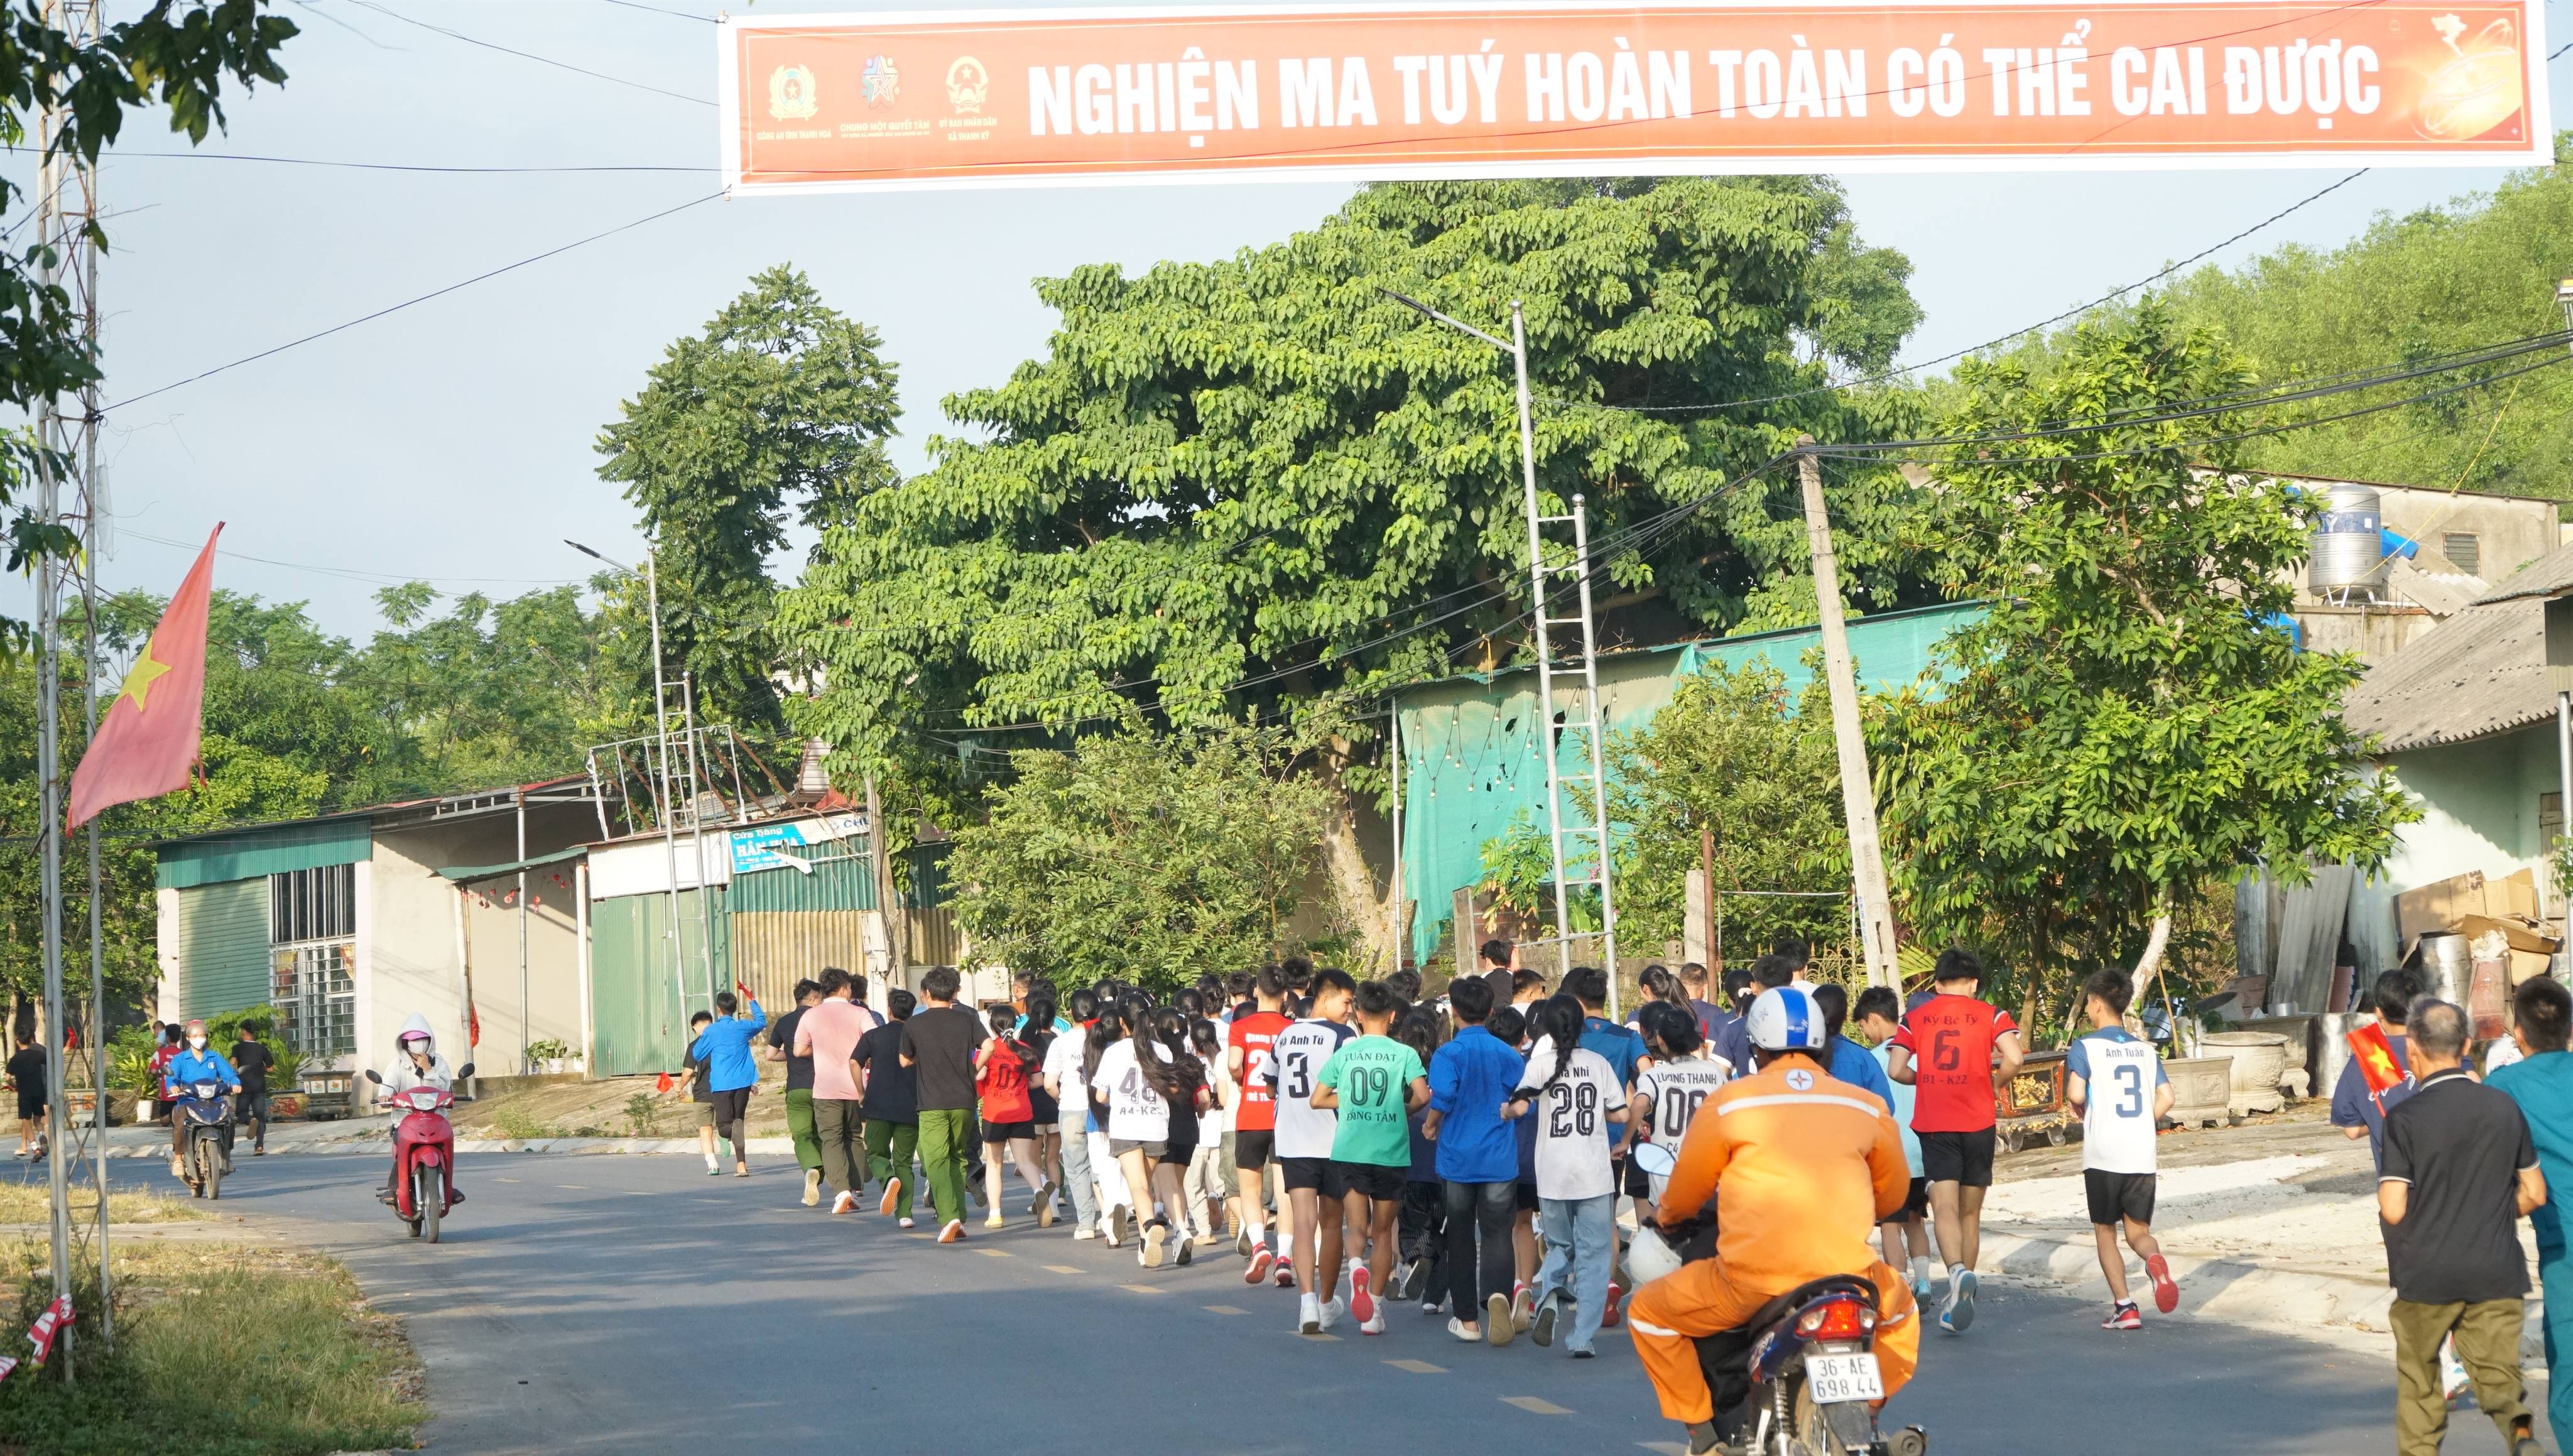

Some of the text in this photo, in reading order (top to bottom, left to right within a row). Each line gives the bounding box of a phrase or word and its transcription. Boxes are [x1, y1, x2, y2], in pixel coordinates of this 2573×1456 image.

[1029, 18, 2380, 147] NGHIỆN MA TUÝ HOÀN TOÀN CÓ THỂ CAI ĐƯỢC
[840, 122, 868, 131] CHUNG
[1290, 1036, 1309, 1045] Anh
[1933, 1030, 1961, 1070] 6
[2105, 1048, 2123, 1058] Anh
[1287, 1052, 1310, 1098] 3
[1350, 1067, 1388, 1107] 09
[1574, 1066, 1589, 1078] Nhi
[1687, 1073, 1717, 1085] THANH
[2114, 1065, 2143, 1118] 3
[1549, 1082, 1597, 1138] 28
[1815, 1377, 1878, 1398] 698.44
